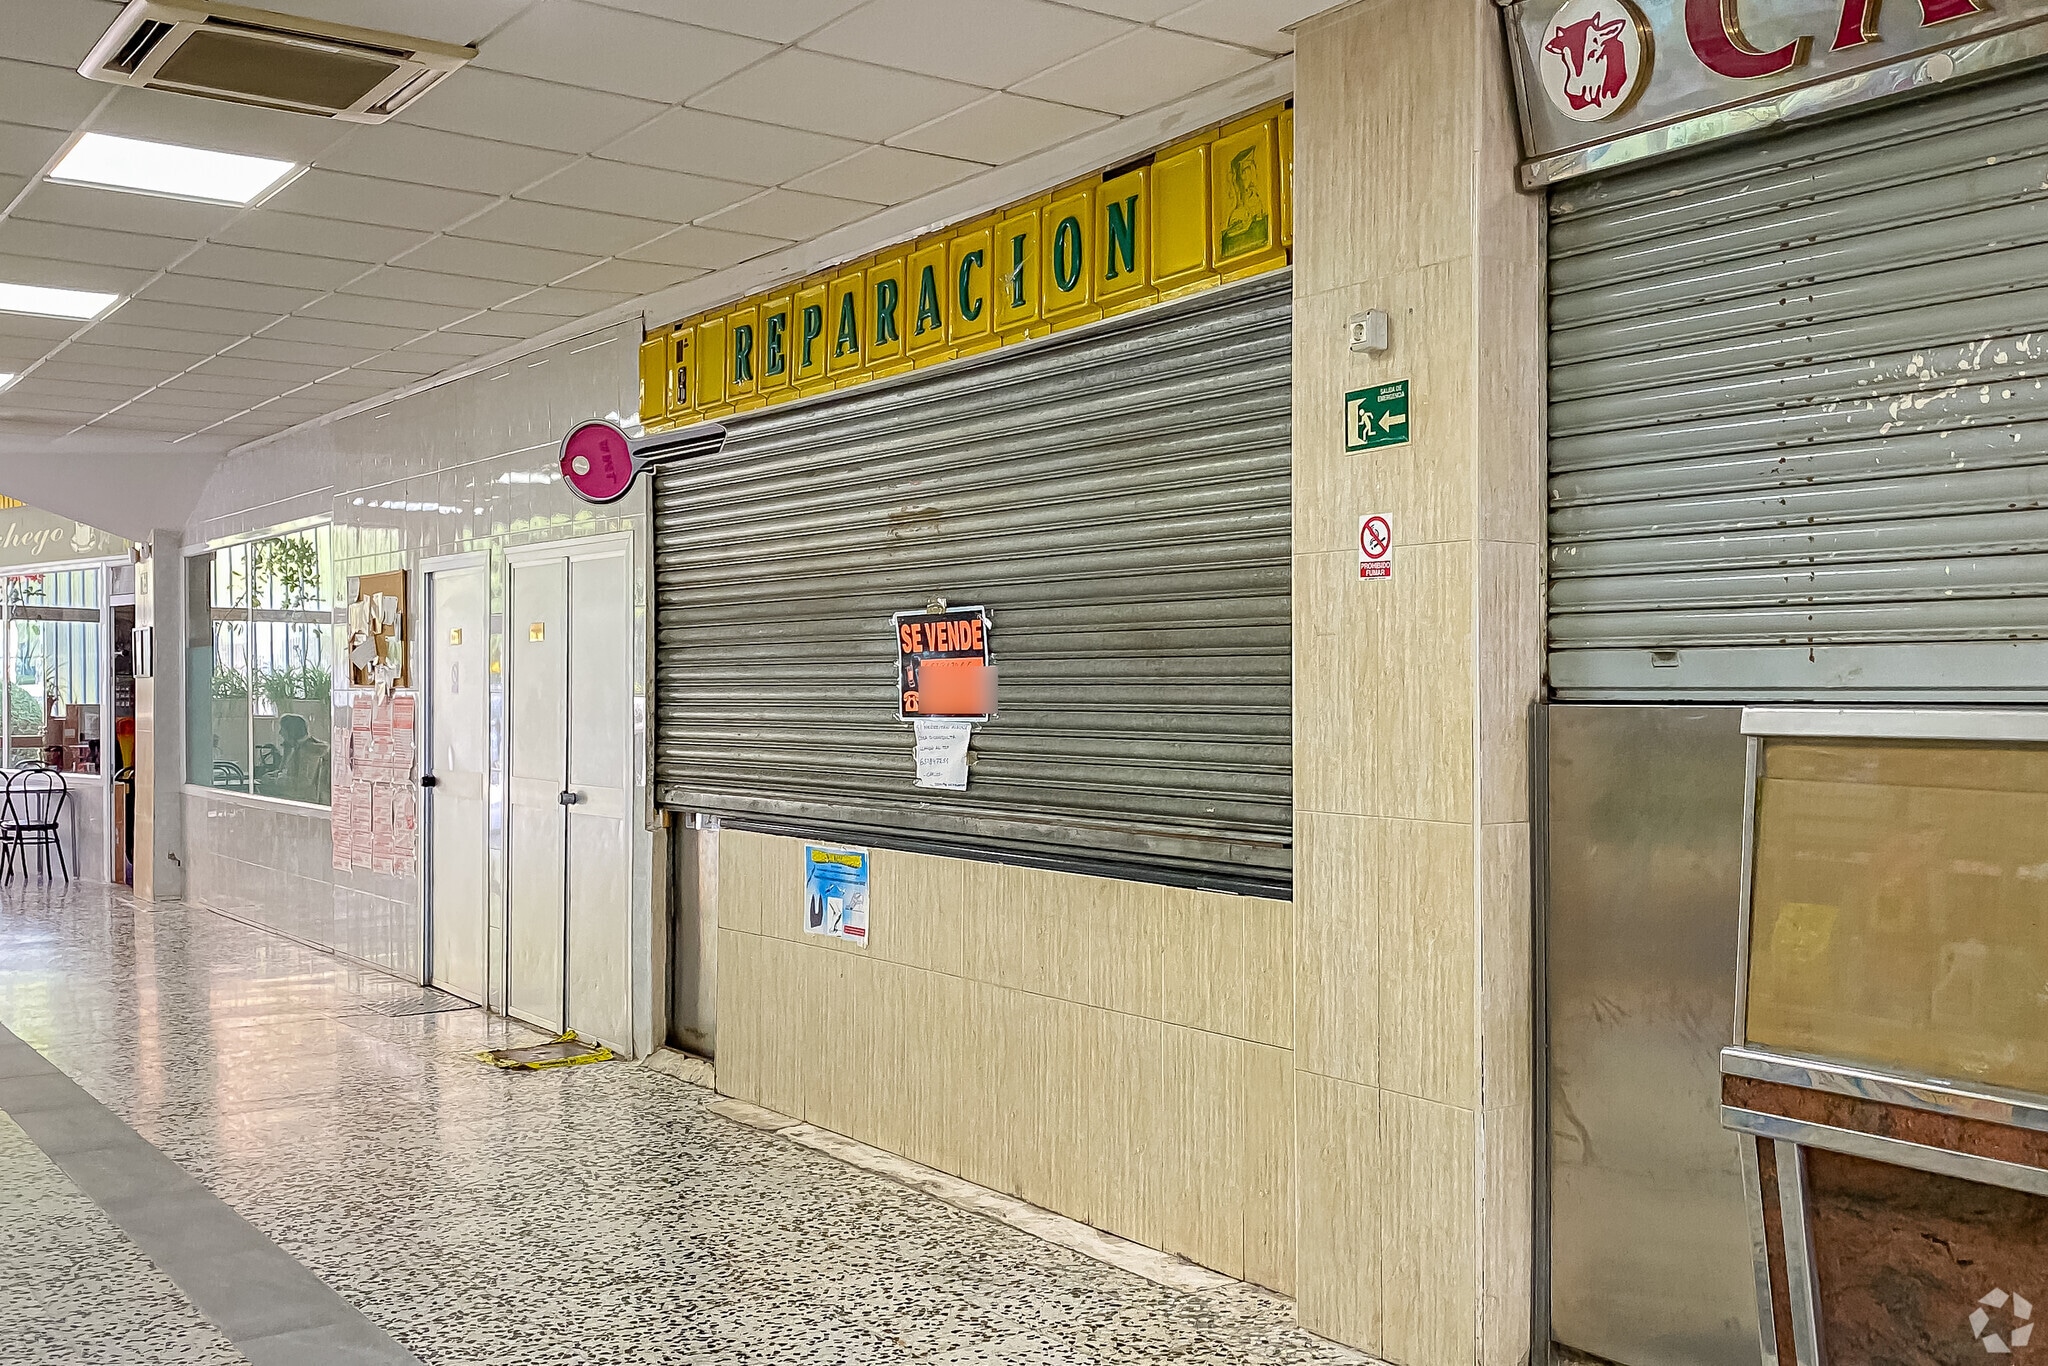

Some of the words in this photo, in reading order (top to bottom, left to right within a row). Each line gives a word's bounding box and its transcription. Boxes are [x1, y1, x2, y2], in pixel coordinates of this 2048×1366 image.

[733, 194, 1139, 385] REPARACION
[0, 522, 64, 556] hego
[1360, 562, 1391, 570] PROHIBIDO
[1365, 569, 1386, 577] FUMAR
[900, 623, 923, 653] SE
[924, 619, 983, 652] VENDE
